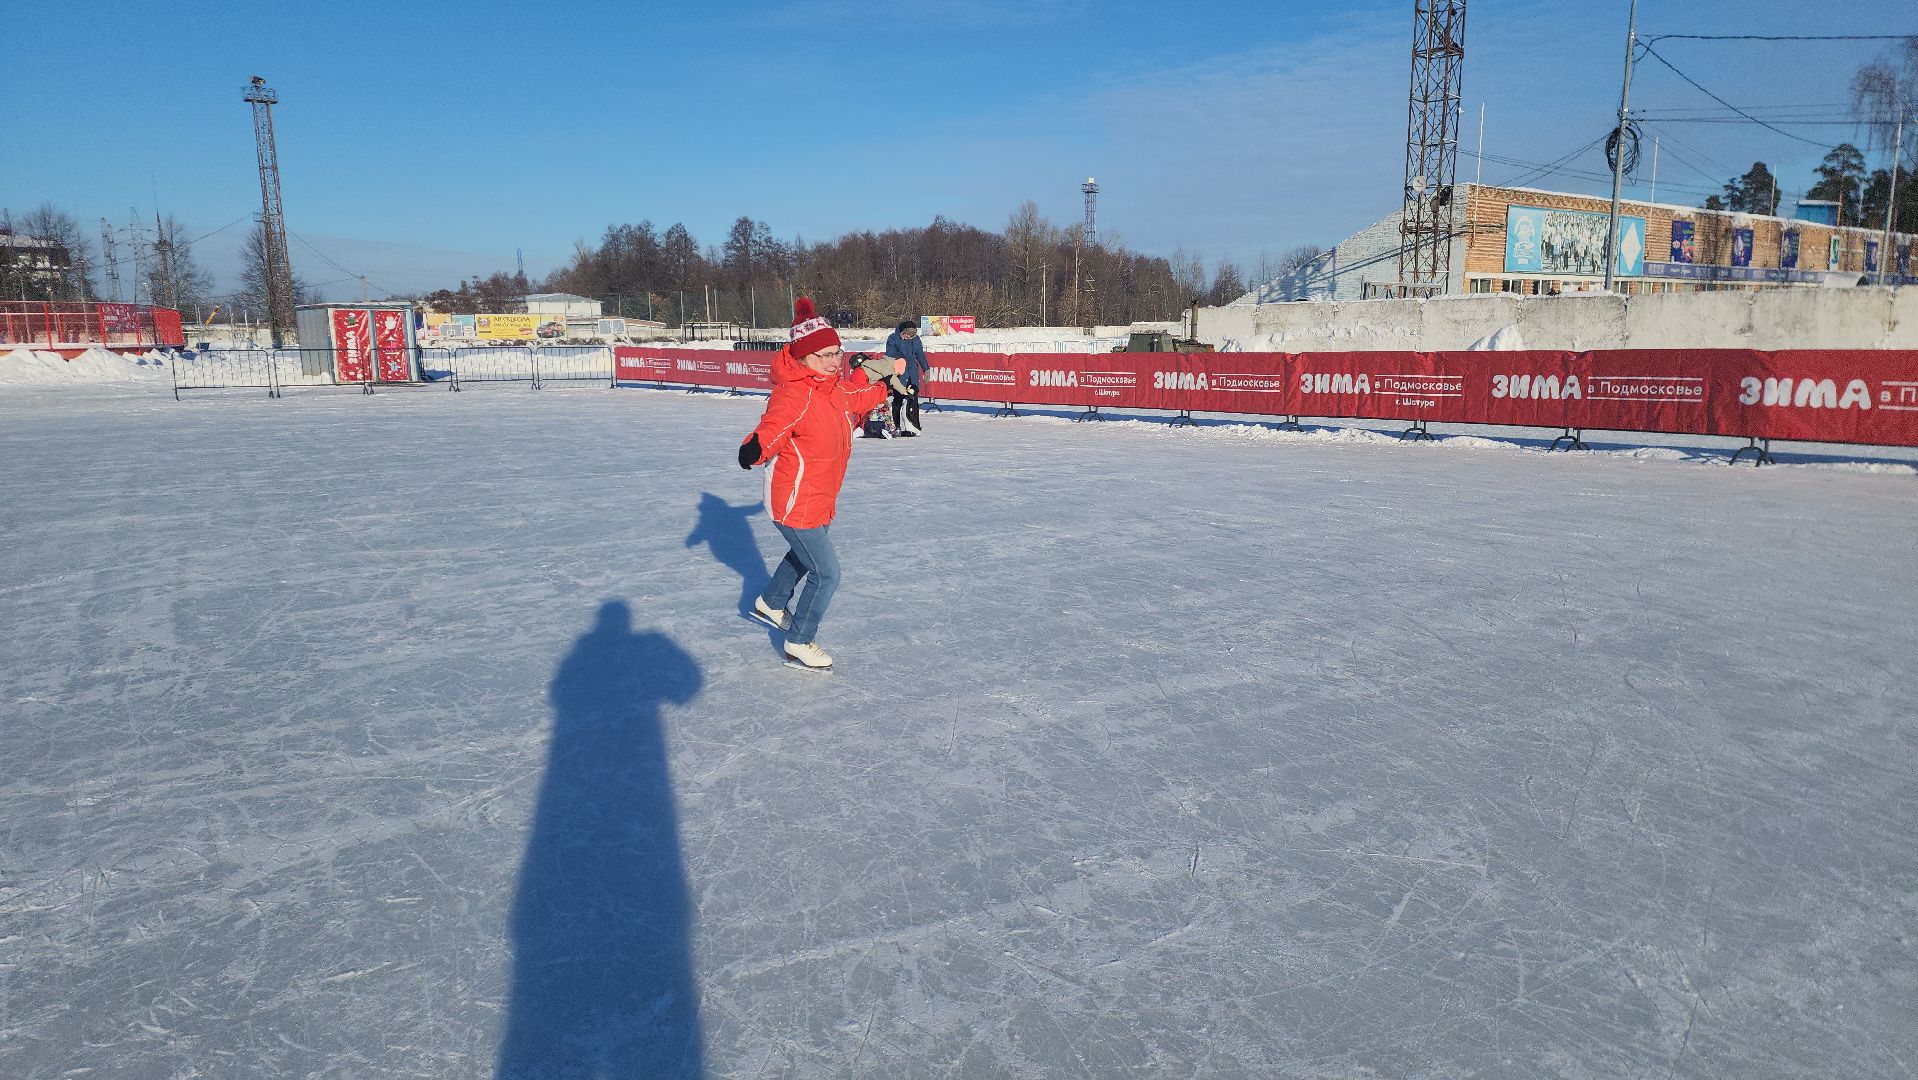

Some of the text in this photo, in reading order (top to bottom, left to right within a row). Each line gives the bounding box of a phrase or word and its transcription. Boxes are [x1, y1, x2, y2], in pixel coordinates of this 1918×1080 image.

[620, 357, 646, 368] ЗИМА
[677, 359, 697, 371] ЗИМА
[923, 367, 963, 383] ИМА
[970, 372, 1016, 382] Подмосковье
[1029, 369, 1079, 388] ЗИМА
[1086, 374, 1137, 384] Подмосковье
[1153, 371, 1209, 390] ЗИМА
[1219, 376, 1281, 388] Подмосковье
[1300, 373, 1463, 395] ЗИМА в Подмосковье
[1491, 374, 1703, 400] ЗИМА в Подмосковье
[1739, 376, 1872, 410] ЗИМА
[1879, 390, 1891, 402] в
[1402, 398, 1435, 409] Шатура
